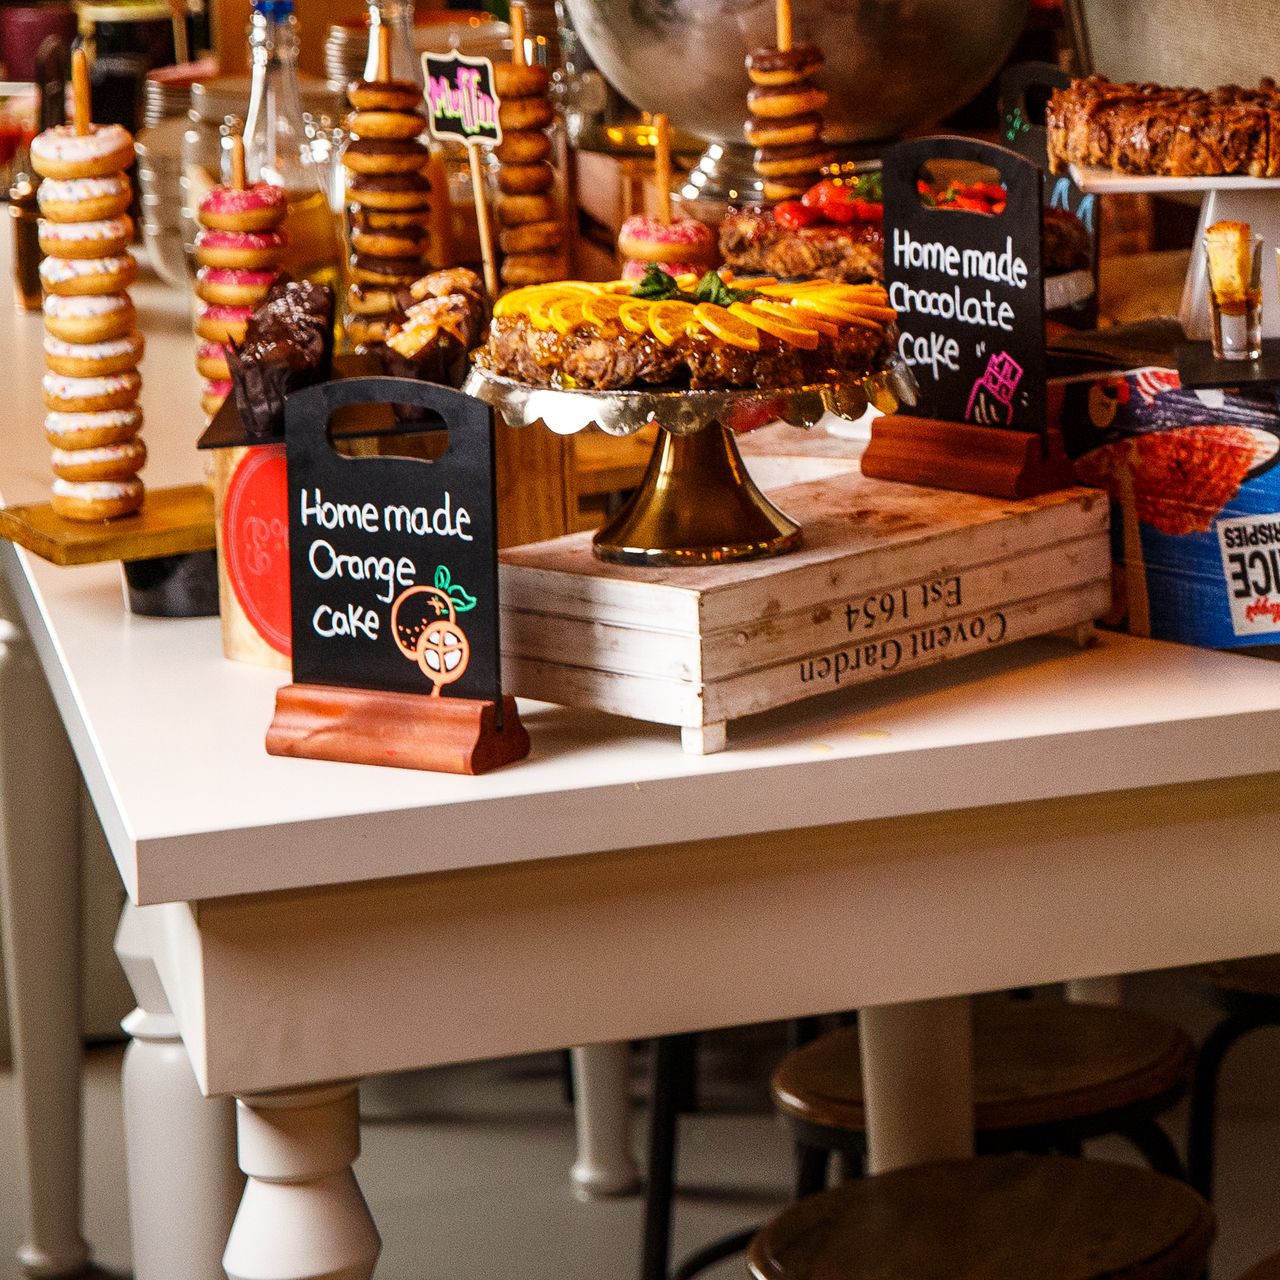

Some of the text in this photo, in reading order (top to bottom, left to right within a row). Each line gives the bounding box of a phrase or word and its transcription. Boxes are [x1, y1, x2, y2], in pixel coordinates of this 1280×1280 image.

[308, 539, 416, 604] Orange
[844, 576, 963, 633] Est 1654
[798, 612, 1008, 684] Covent Garden
